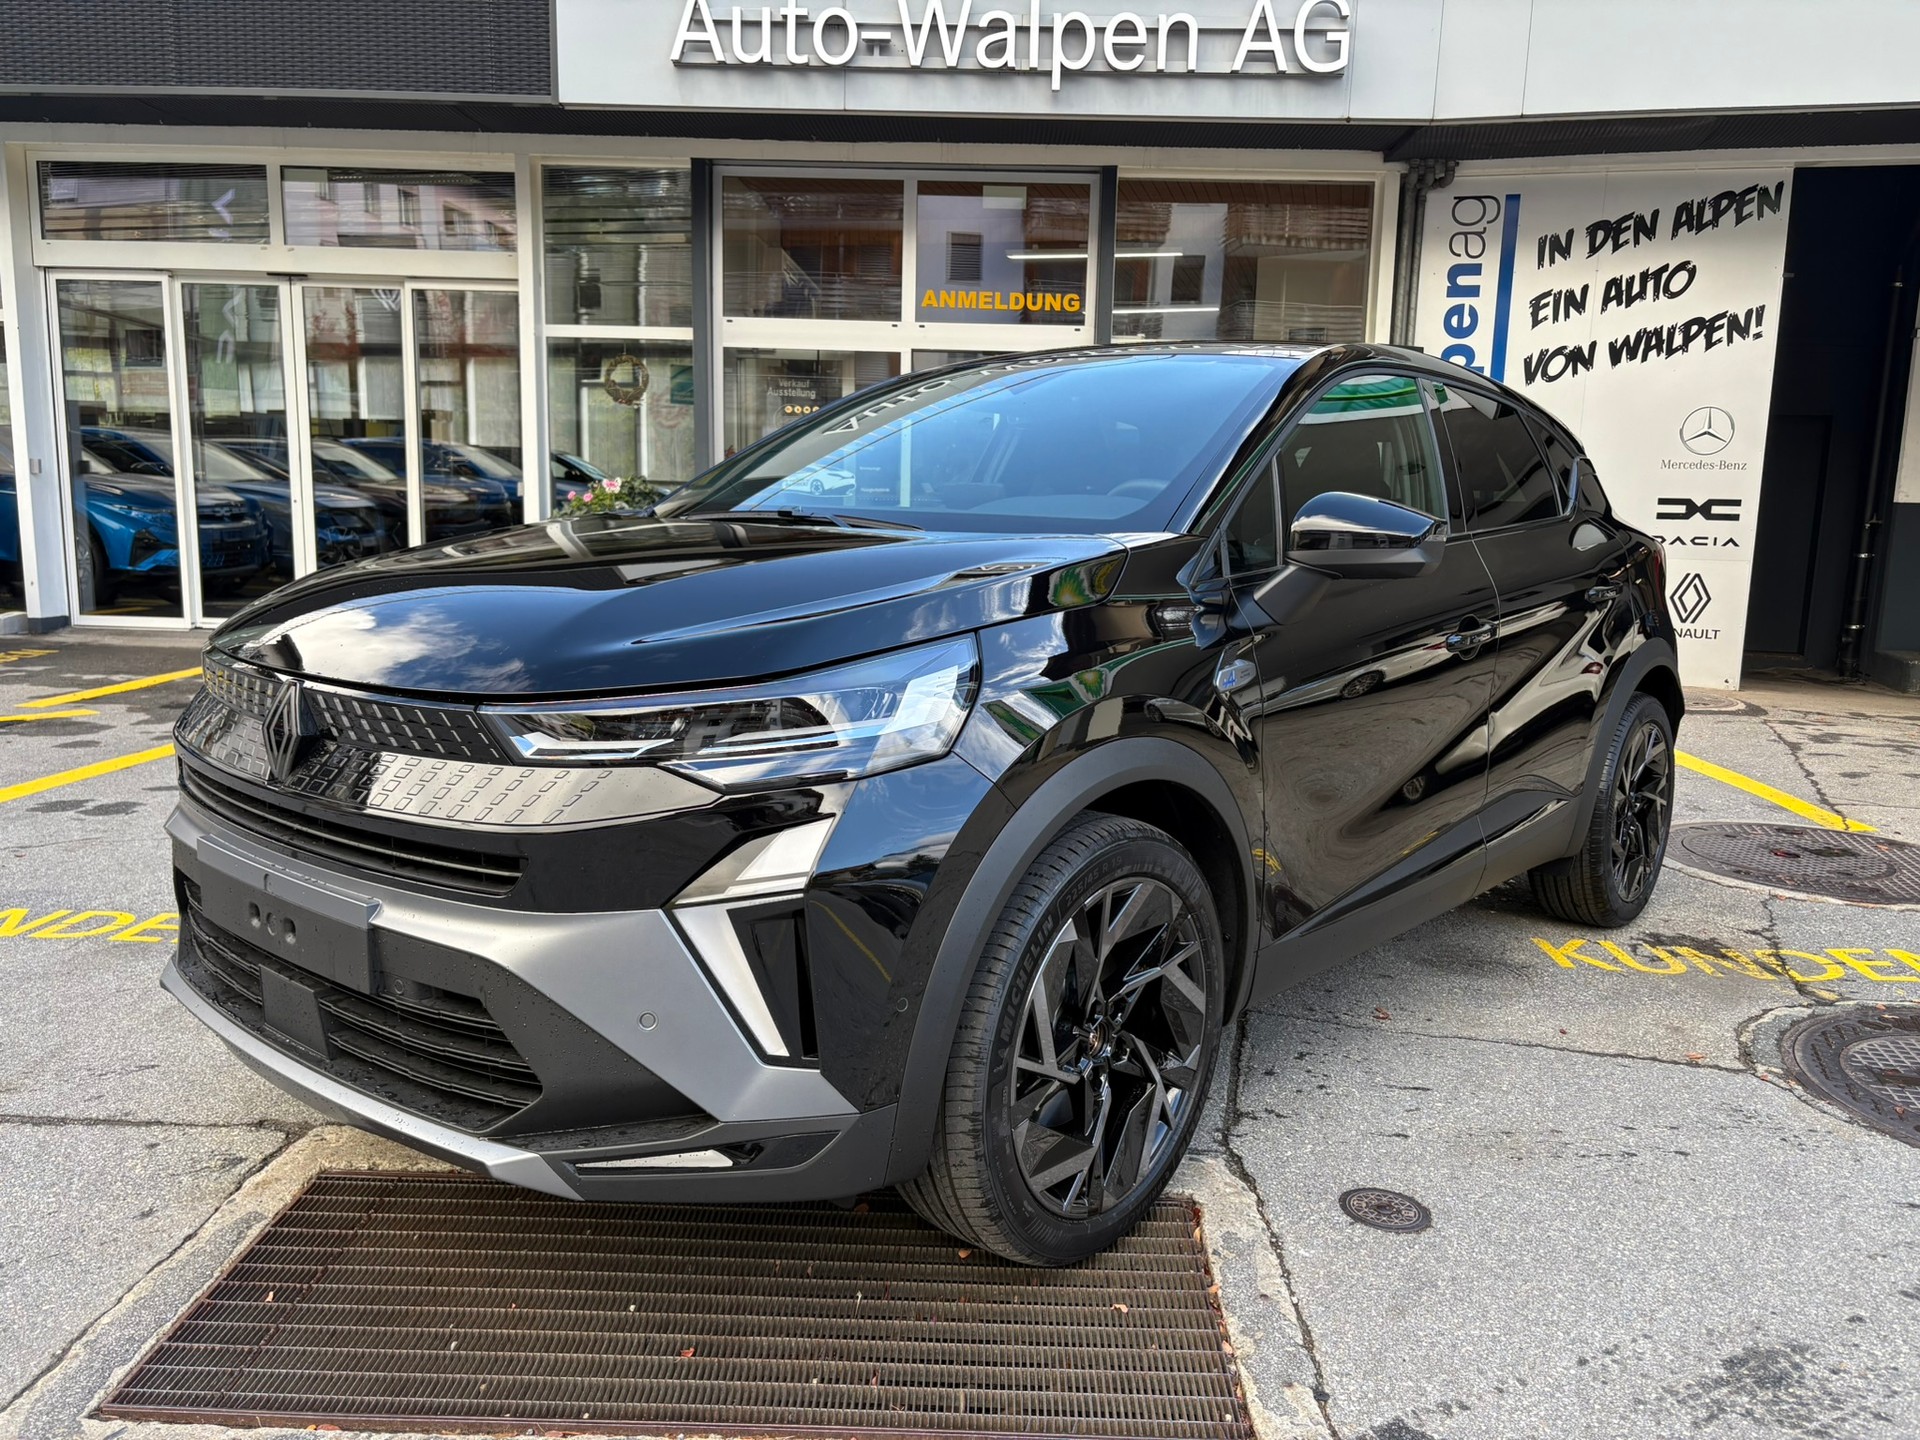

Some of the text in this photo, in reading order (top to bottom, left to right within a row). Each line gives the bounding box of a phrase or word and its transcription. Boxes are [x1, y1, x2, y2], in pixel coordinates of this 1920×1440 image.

[670, 0, 1352, 91] Auto-Walpen AG
[1537, 180, 1785, 270] IN DEN ALPEN
[921, 288, 1081, 313] ANMELDUNG
[1529, 259, 1698, 330] EIN AUTO
[1522, 304, 1768, 386] VON WALPEN!
[766, 386, 816, 400] Ausstellung
[779, 378, 810, 388] Verkauf
[1659, 459, 1748, 471] Mercedes-Benz
[0, 908, 181, 944] NDE
[999, 914, 1055, 1043] MICHELIN
